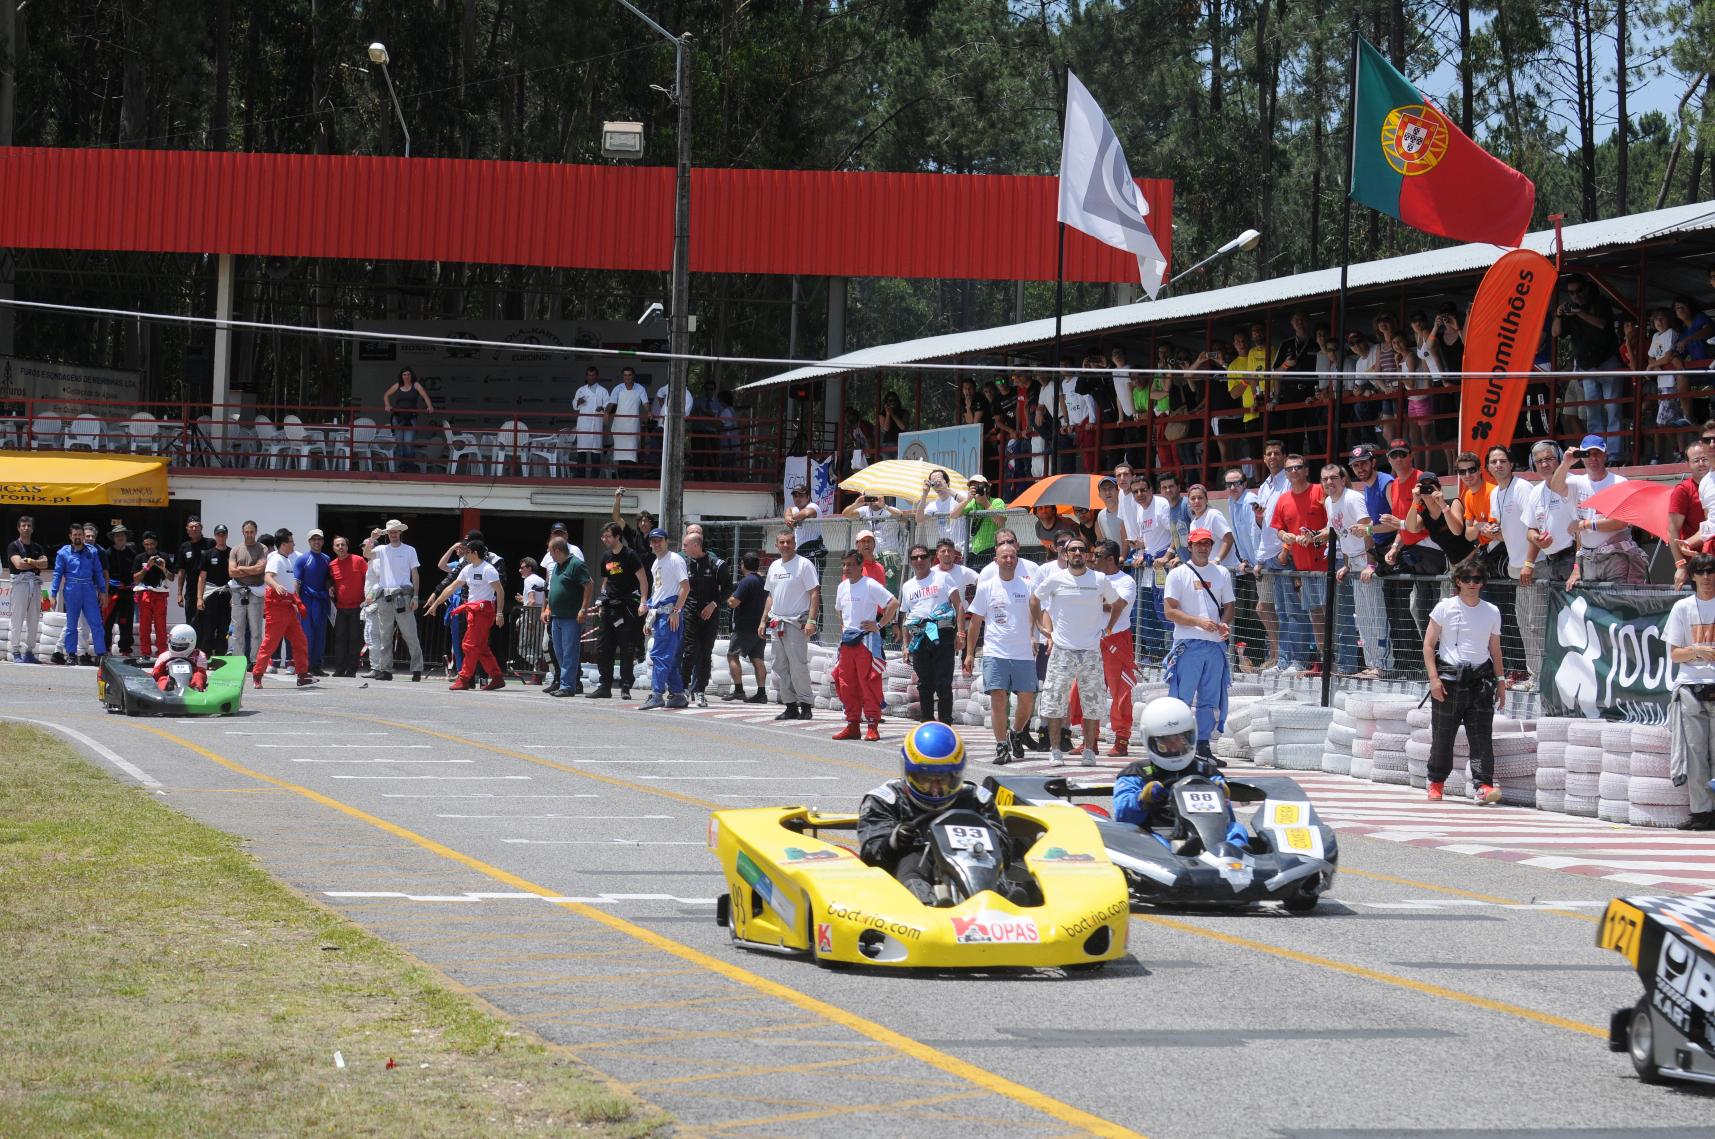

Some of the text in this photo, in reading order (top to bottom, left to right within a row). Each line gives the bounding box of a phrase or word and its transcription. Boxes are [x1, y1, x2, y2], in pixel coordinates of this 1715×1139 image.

[1481, 268, 1534, 419] euromilhões
[1616, 697, 1672, 725] SANTA
[1190, 793, 1212, 802] 88
[952, 827, 984, 839] 93
[1609, 909, 1638, 957] 127
[1653, 989, 1691, 1033] KART
